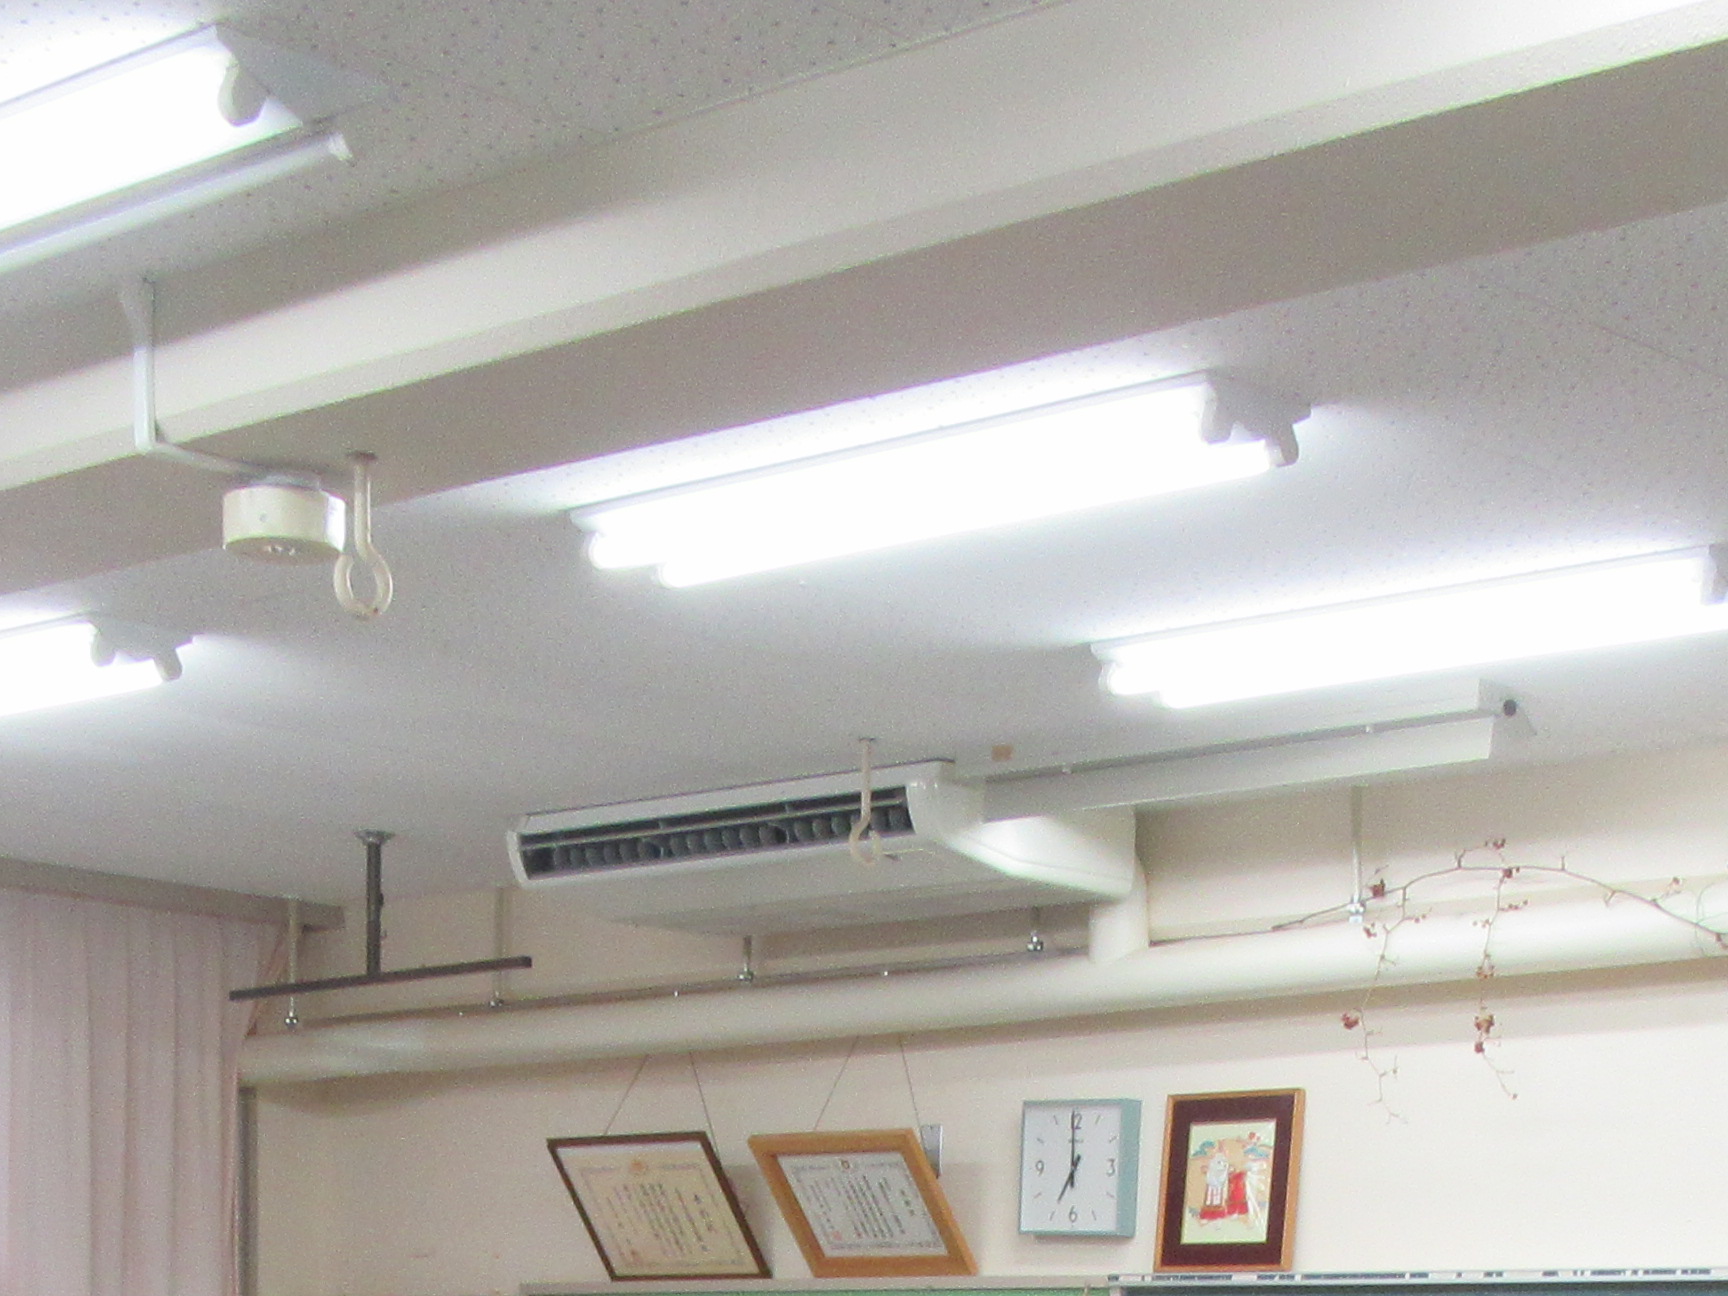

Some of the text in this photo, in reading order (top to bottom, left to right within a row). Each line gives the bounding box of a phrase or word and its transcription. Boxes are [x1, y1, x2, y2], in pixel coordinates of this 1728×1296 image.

[1035, 1160, 1045, 1177] 9
[1106, 1158, 1116, 1178] 3
[1068, 1205, 1078, 1223] 6
